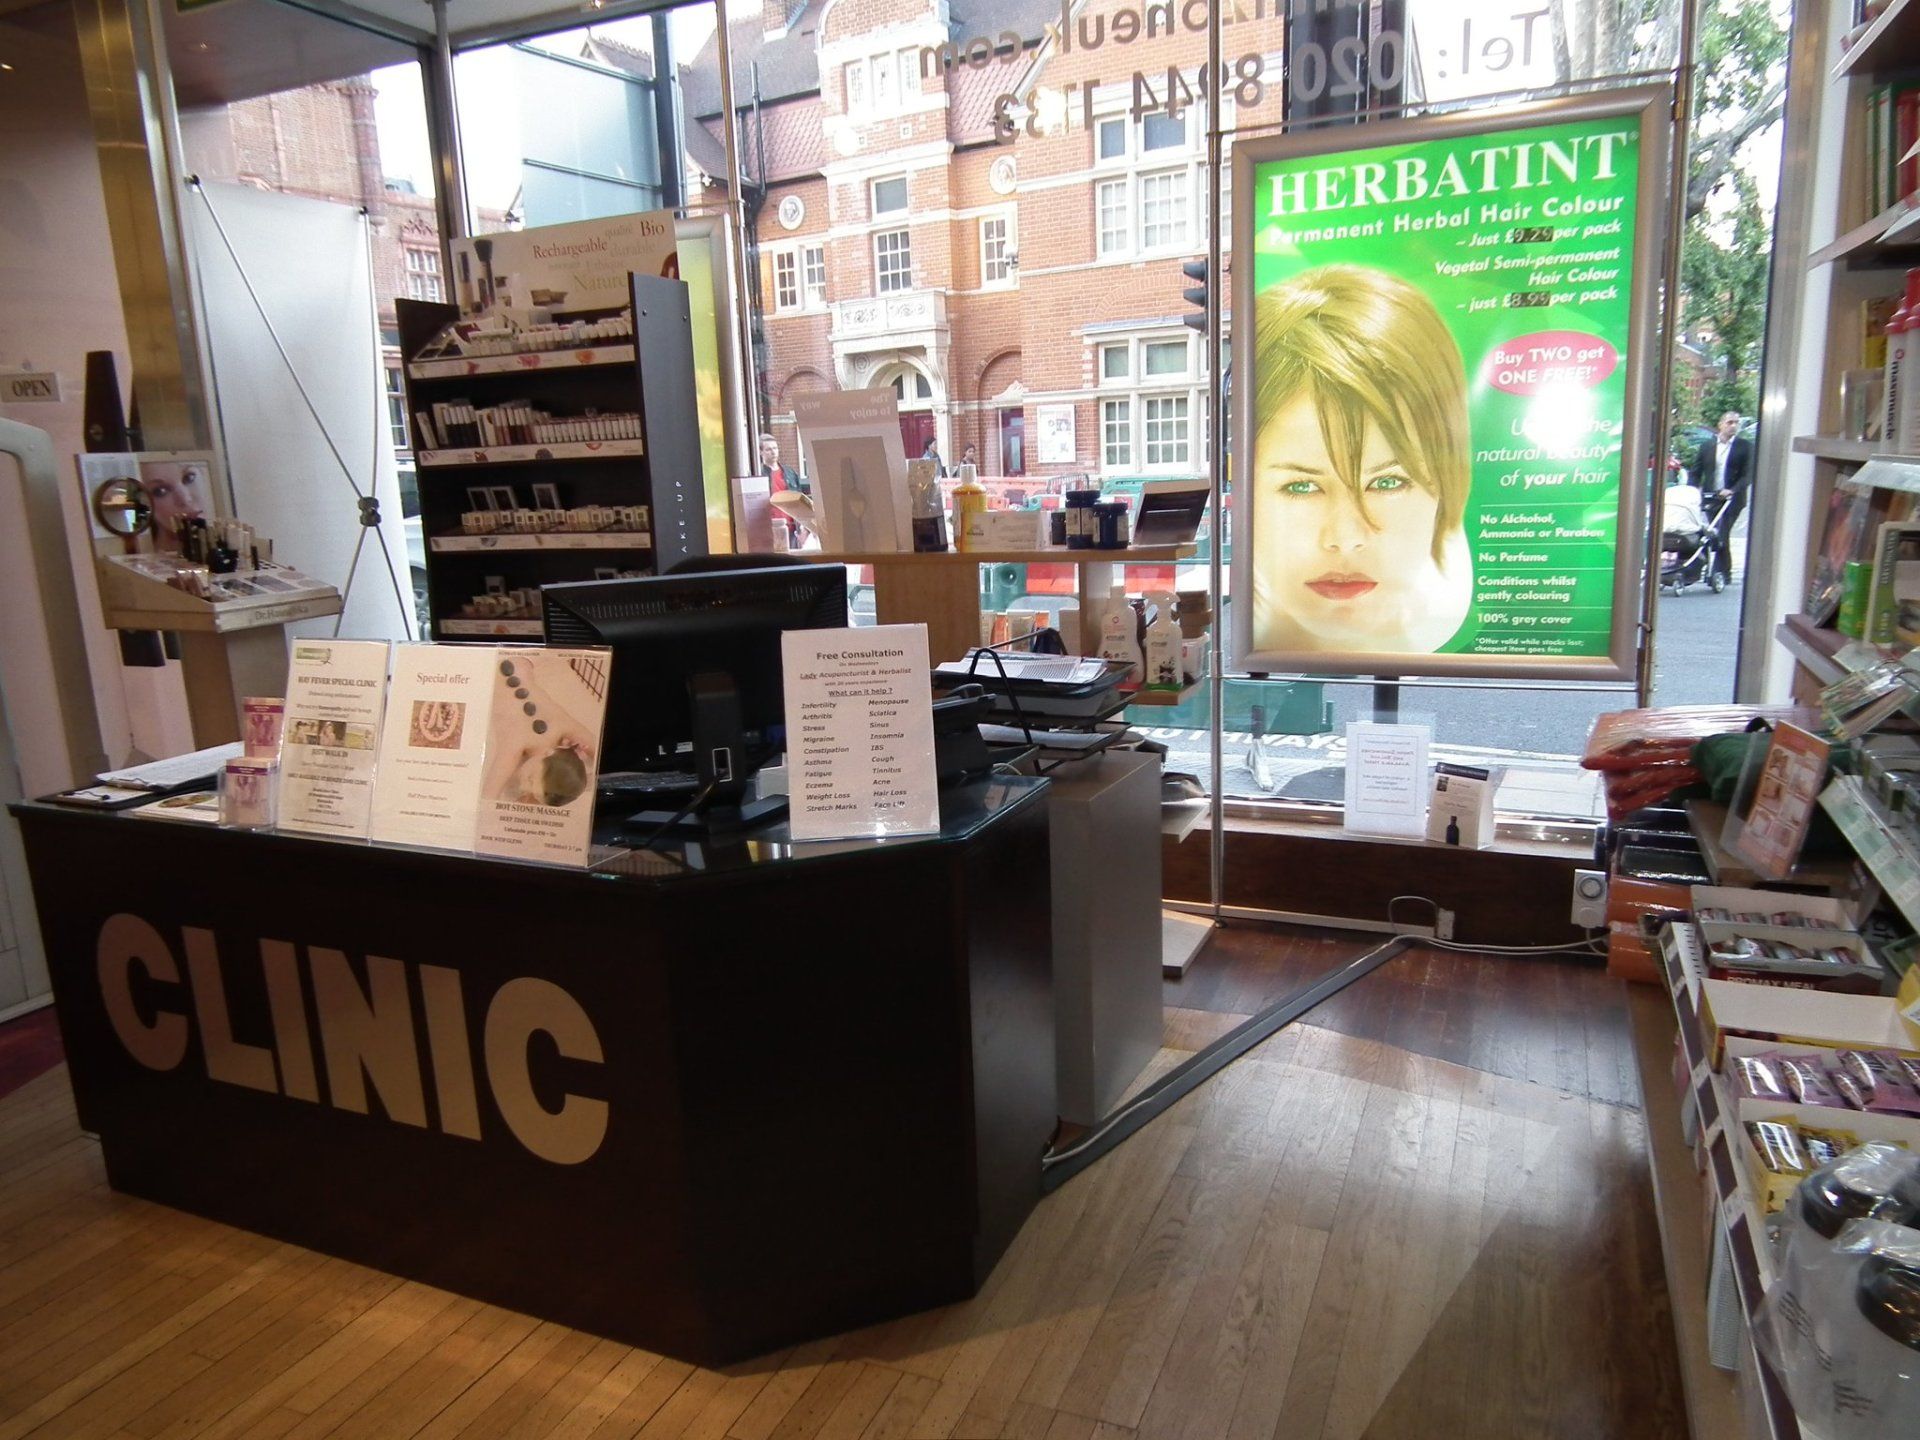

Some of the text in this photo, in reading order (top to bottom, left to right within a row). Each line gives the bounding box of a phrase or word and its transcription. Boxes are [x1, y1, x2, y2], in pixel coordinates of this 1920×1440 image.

[1268, 131, 1628, 217] HERBATINT
[1393, 207, 1470, 232] Herbal
[1480, 202, 1533, 224] Hair
[1542, 194, 1625, 217] Colour
[641, 219, 665, 238] Bio
[1553, 227, 1579, 241] per
[1582, 218, 1623, 238] pack
[532, 235, 609, 260] Rechargeable
[1434, 246, 1621, 277] Vegetal Semi-permanent
[1528, 266, 1620, 286] Hair Colour
[1469, 297, 1498, 313] just
[1549, 292, 1576, 306] per
[1579, 285, 1618, 304] pack
[1495, 346, 1606, 367] Buy TWO get
[1498, 370, 1537, 385] ONE
[12, 378, 52, 397] OPEN
[1476, 446, 1540, 462] natural
[1500, 468, 1611, 490] of your hair
[1480, 514, 1498, 524] No
[1479, 528, 1535, 539] Ammonia
[1479, 551, 1549, 562] No Perfume
[1477, 575, 1577, 586] Conditions whilst
[1477, 590, 1571, 602] gently colouring
[1477, 613, 1573, 626] 100% grey cover
[816, 648, 904, 660] Free Consultation
[416, 672, 471, 686] Special offer
[819, 670, 869, 679] Acupuncturist
[878, 667, 911, 676] Herbalist
[828, 689, 848, 698] What
[871, 688, 886, 697] help
[801, 701, 837, 710] Infertility
[868, 699, 909, 707] Menopause
[802, 713, 832, 721] Arthritis
[803, 736, 835, 744] Migraine
[870, 732, 904, 740] Insomnia
[803, 746, 849, 755] Constipation
[806, 793, 832, 801] Weight
[512, 803, 534, 813] STONE
[537, 806, 571, 817] MASSAGE
[97, 913, 609, 1165] CLINIC
